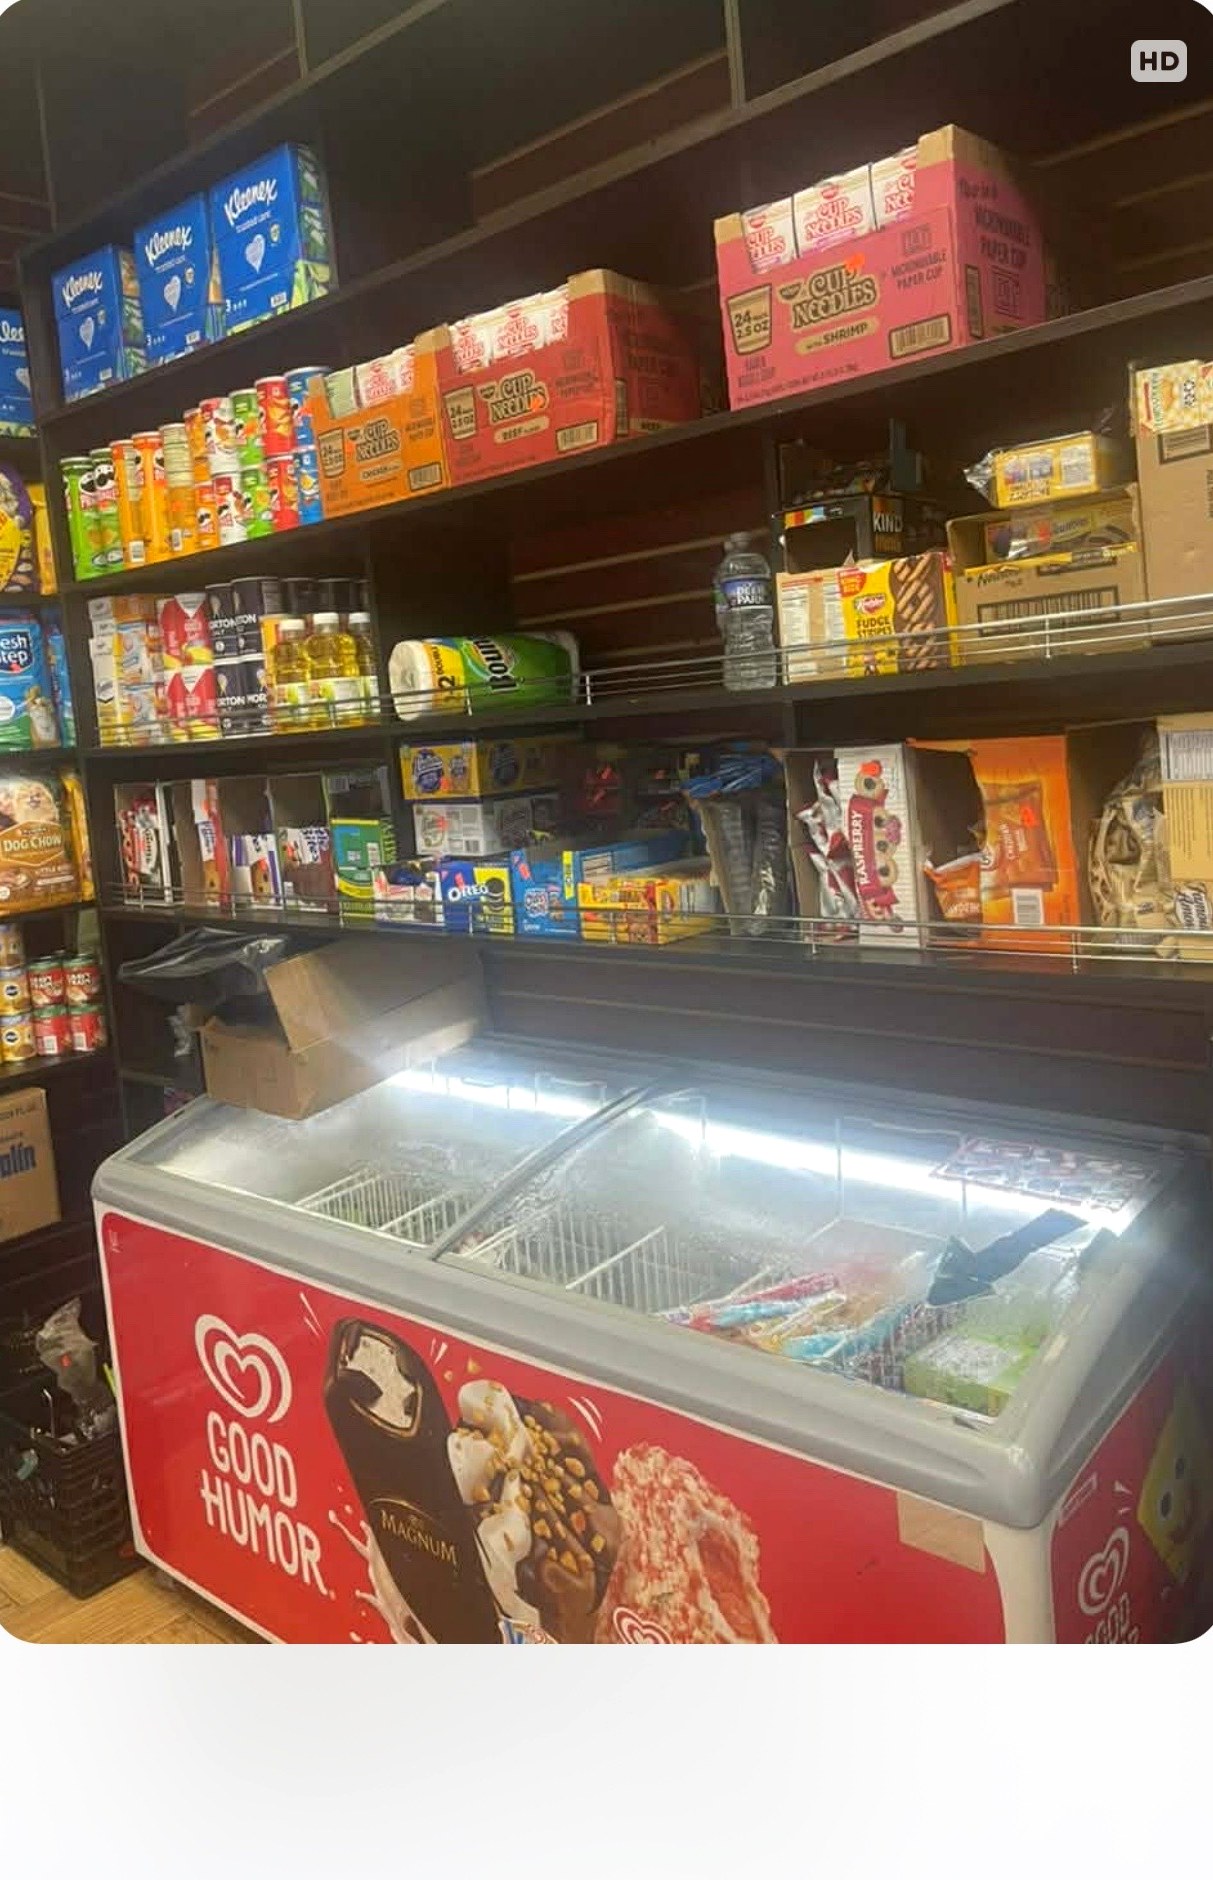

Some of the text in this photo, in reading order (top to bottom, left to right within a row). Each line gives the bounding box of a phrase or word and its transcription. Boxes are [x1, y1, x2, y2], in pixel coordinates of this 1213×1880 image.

[224, 178, 278, 226] Kleenex
[805, 206, 865, 241] NOODLES
[145, 225, 193, 267] Kleenex
[62, 270, 103, 309] Kleenex
[792, 278, 877, 329] NOODLES
[734, 309, 751, 328] 24
[753, 320, 769, 333] OZ
[823, 321, 869, 345] SHRIMP
[501, 372, 533, 400] CUP
[872, 512, 903, 533] KIND
[856, 616, 891, 629] FUDGE
[3, 835, 62, 852] DOG CHOW
[851, 810, 872, 885] RASPBERRY
[447, 884, 489, 902] OREO
[207, 1410, 298, 1509] GOOD
[200, 1468, 329, 1596] HUMOR
[380, 1508, 458, 1566] MAGNUM
